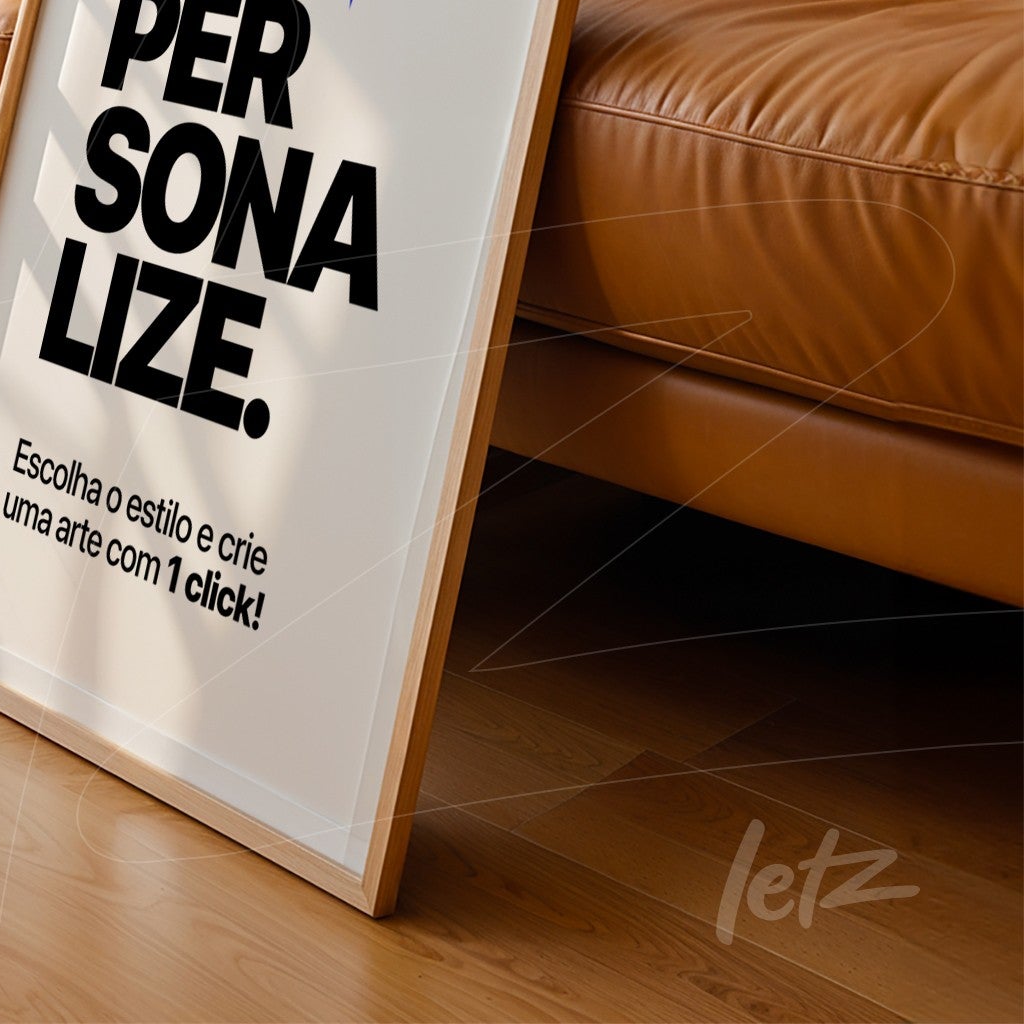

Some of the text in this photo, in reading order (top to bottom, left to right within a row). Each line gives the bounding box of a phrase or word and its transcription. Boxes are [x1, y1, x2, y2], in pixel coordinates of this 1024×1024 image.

[74, 105, 379, 311] SONA
[39, 237, 271, 439] LIZE.
[2, 491, 266, 631] uma arte com 1 click!
[12, 437, 268, 576] Escolha o estilo e crie
